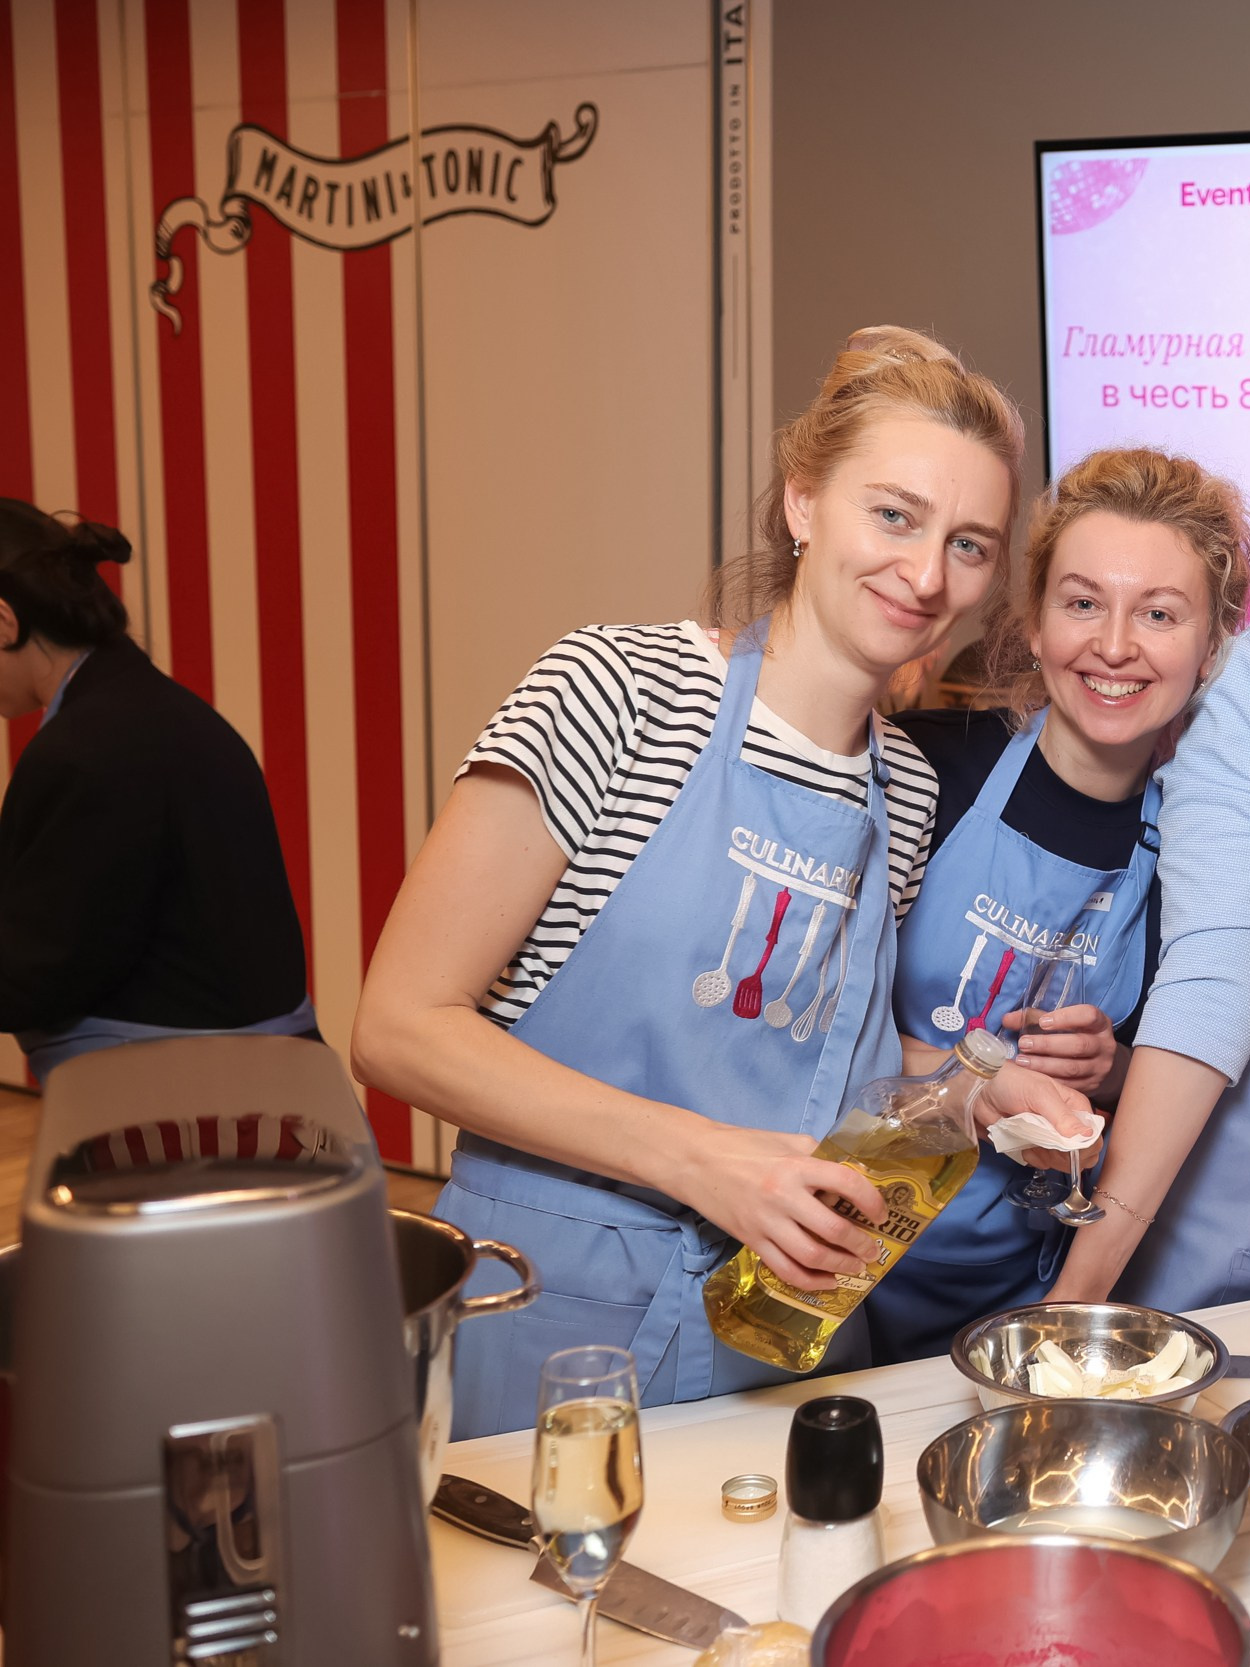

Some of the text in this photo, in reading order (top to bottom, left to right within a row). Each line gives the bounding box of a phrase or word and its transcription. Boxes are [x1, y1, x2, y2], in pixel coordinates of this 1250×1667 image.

[254, 146, 397, 227] MARTINI
[421, 146, 524, 204] TONIC
[1062, 325, 1245, 366] Гламурная
[1102, 384, 1120, 408] в
[1129, 383, 1230, 410] честь
